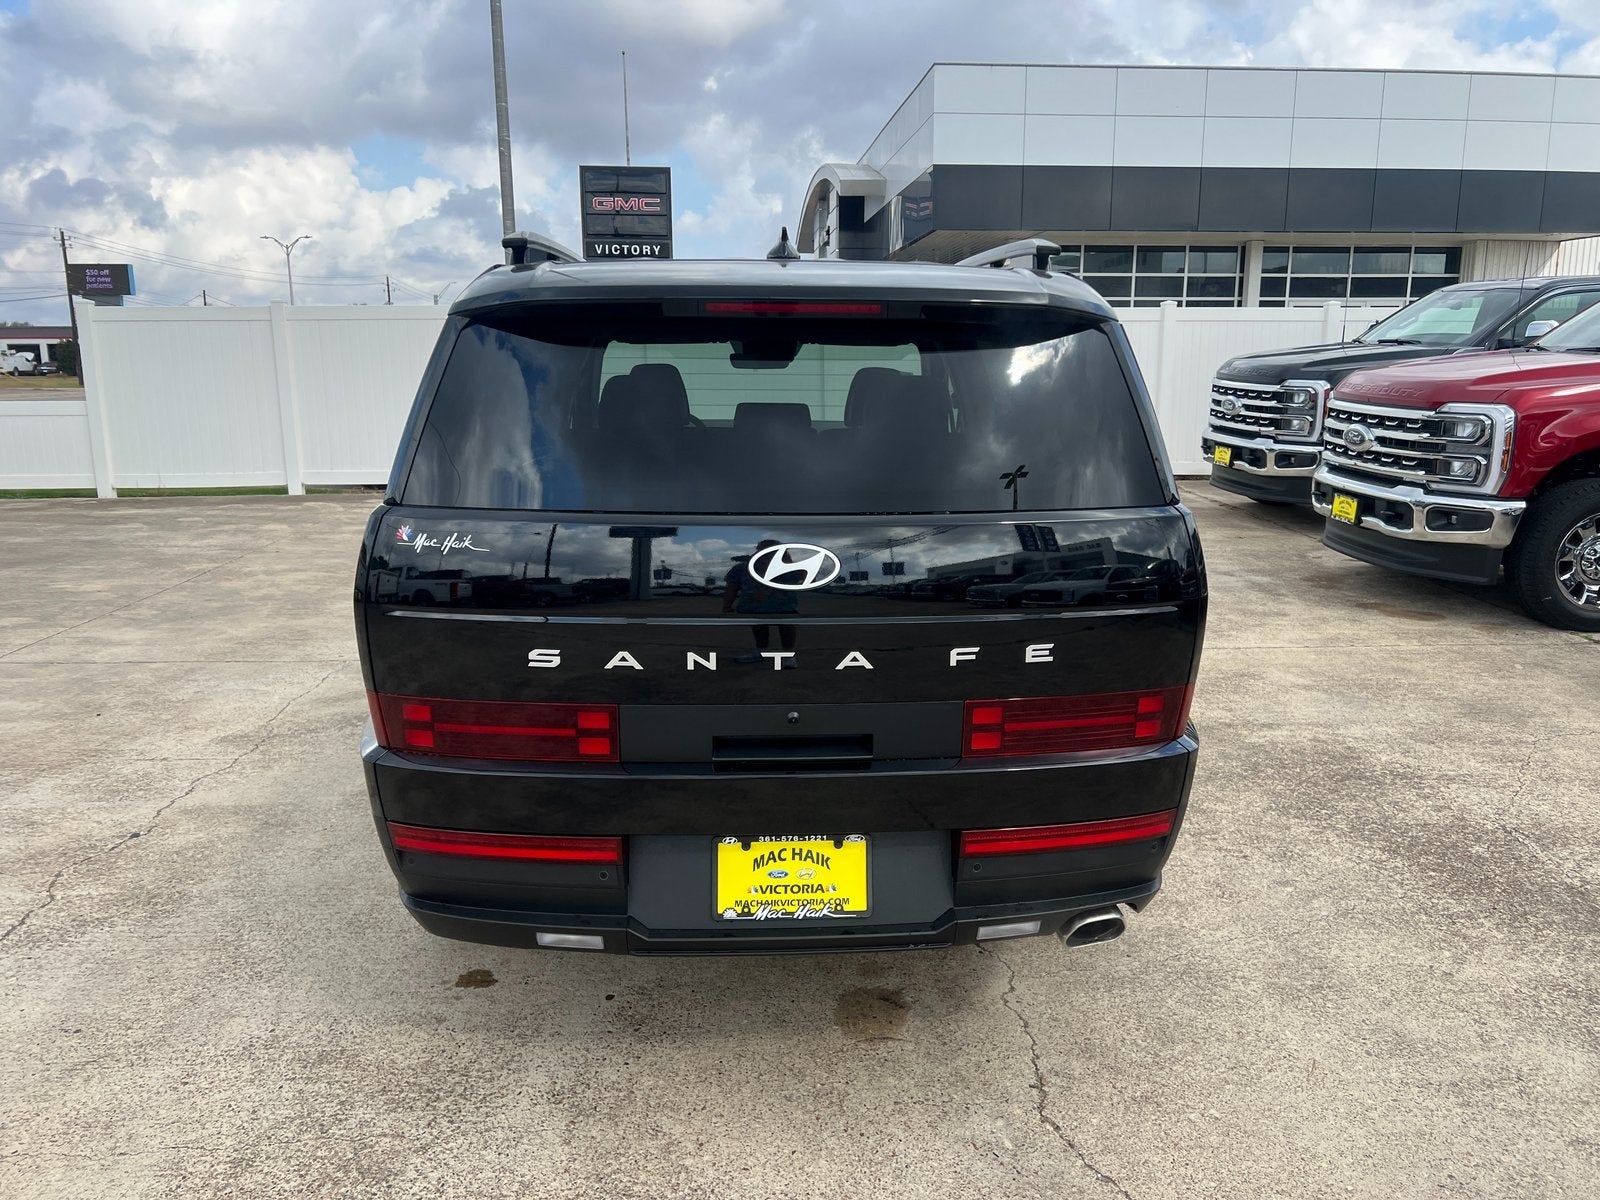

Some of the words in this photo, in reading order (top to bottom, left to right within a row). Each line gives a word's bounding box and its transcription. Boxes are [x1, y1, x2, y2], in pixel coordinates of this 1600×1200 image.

[592, 196, 661, 212] GMC
[594, 244, 661, 255] VICTORY
[405, 532, 441, 553] Mac
[441, 532, 485, 555] Haik
[527, 648, 874, 671] SANTA
[950, 643, 1054, 667] FE
[753, 847, 787, 871] MAC
[791, 847, 831, 870] HAIK
[759, 883, 825, 895] VICTORIA
[734, 897, 850, 908] MACHAIKVICTORIACOM
[750, 904, 792, 921] Mac
[793, 903, 845, 920] Haik
